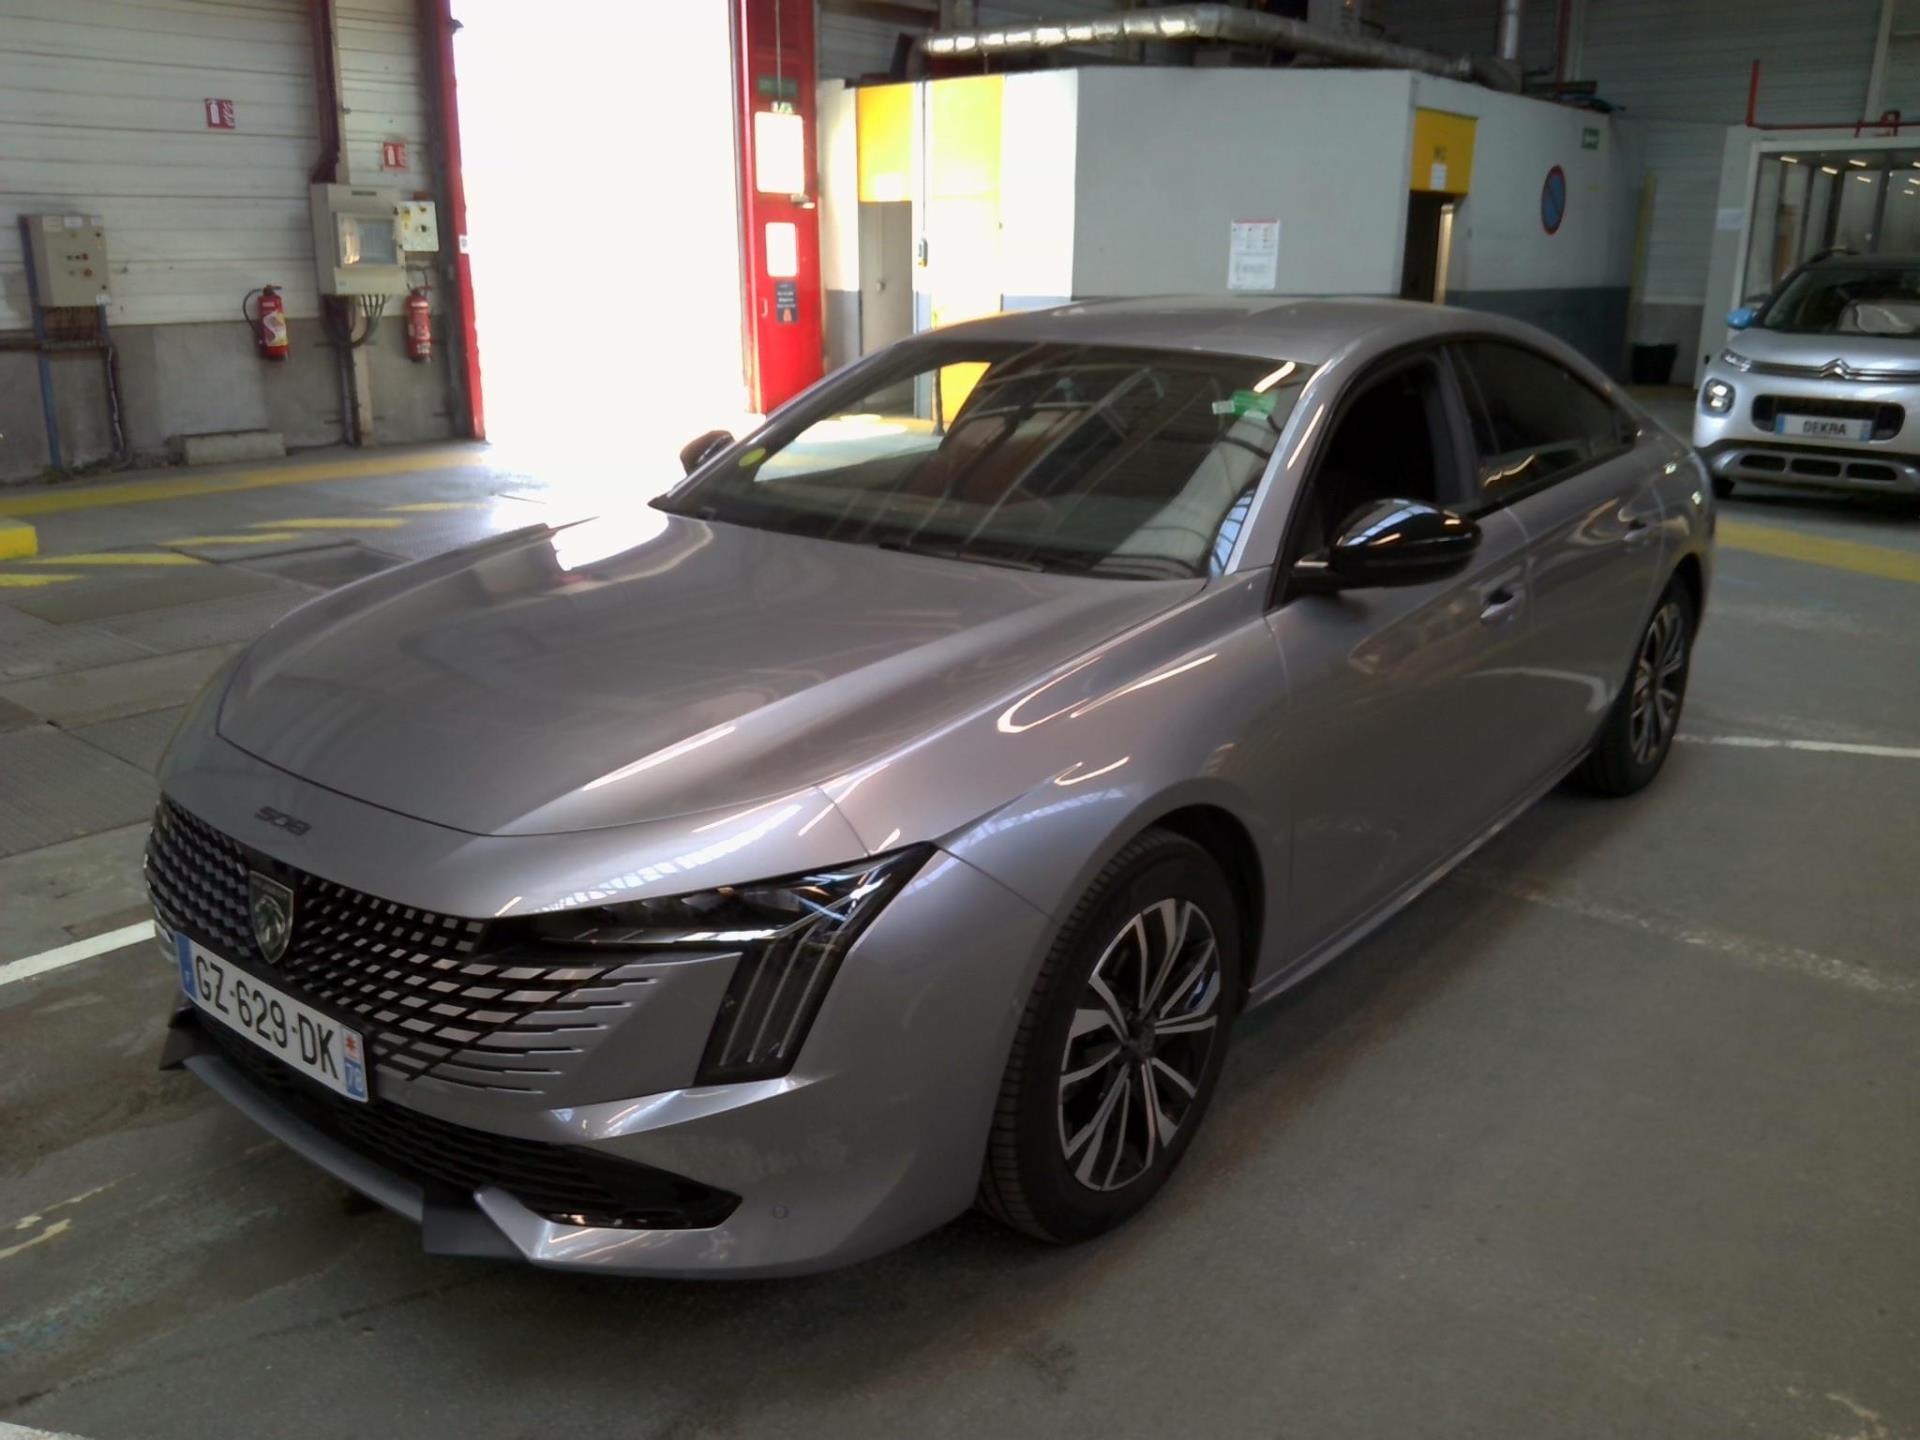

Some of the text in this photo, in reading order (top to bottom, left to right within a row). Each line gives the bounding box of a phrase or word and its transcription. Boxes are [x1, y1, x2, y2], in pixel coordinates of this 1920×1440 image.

[1803, 420, 1847, 435] DEKRA
[254, 806, 312, 836] 508
[195, 955, 338, 1080] GZ-629-DK
